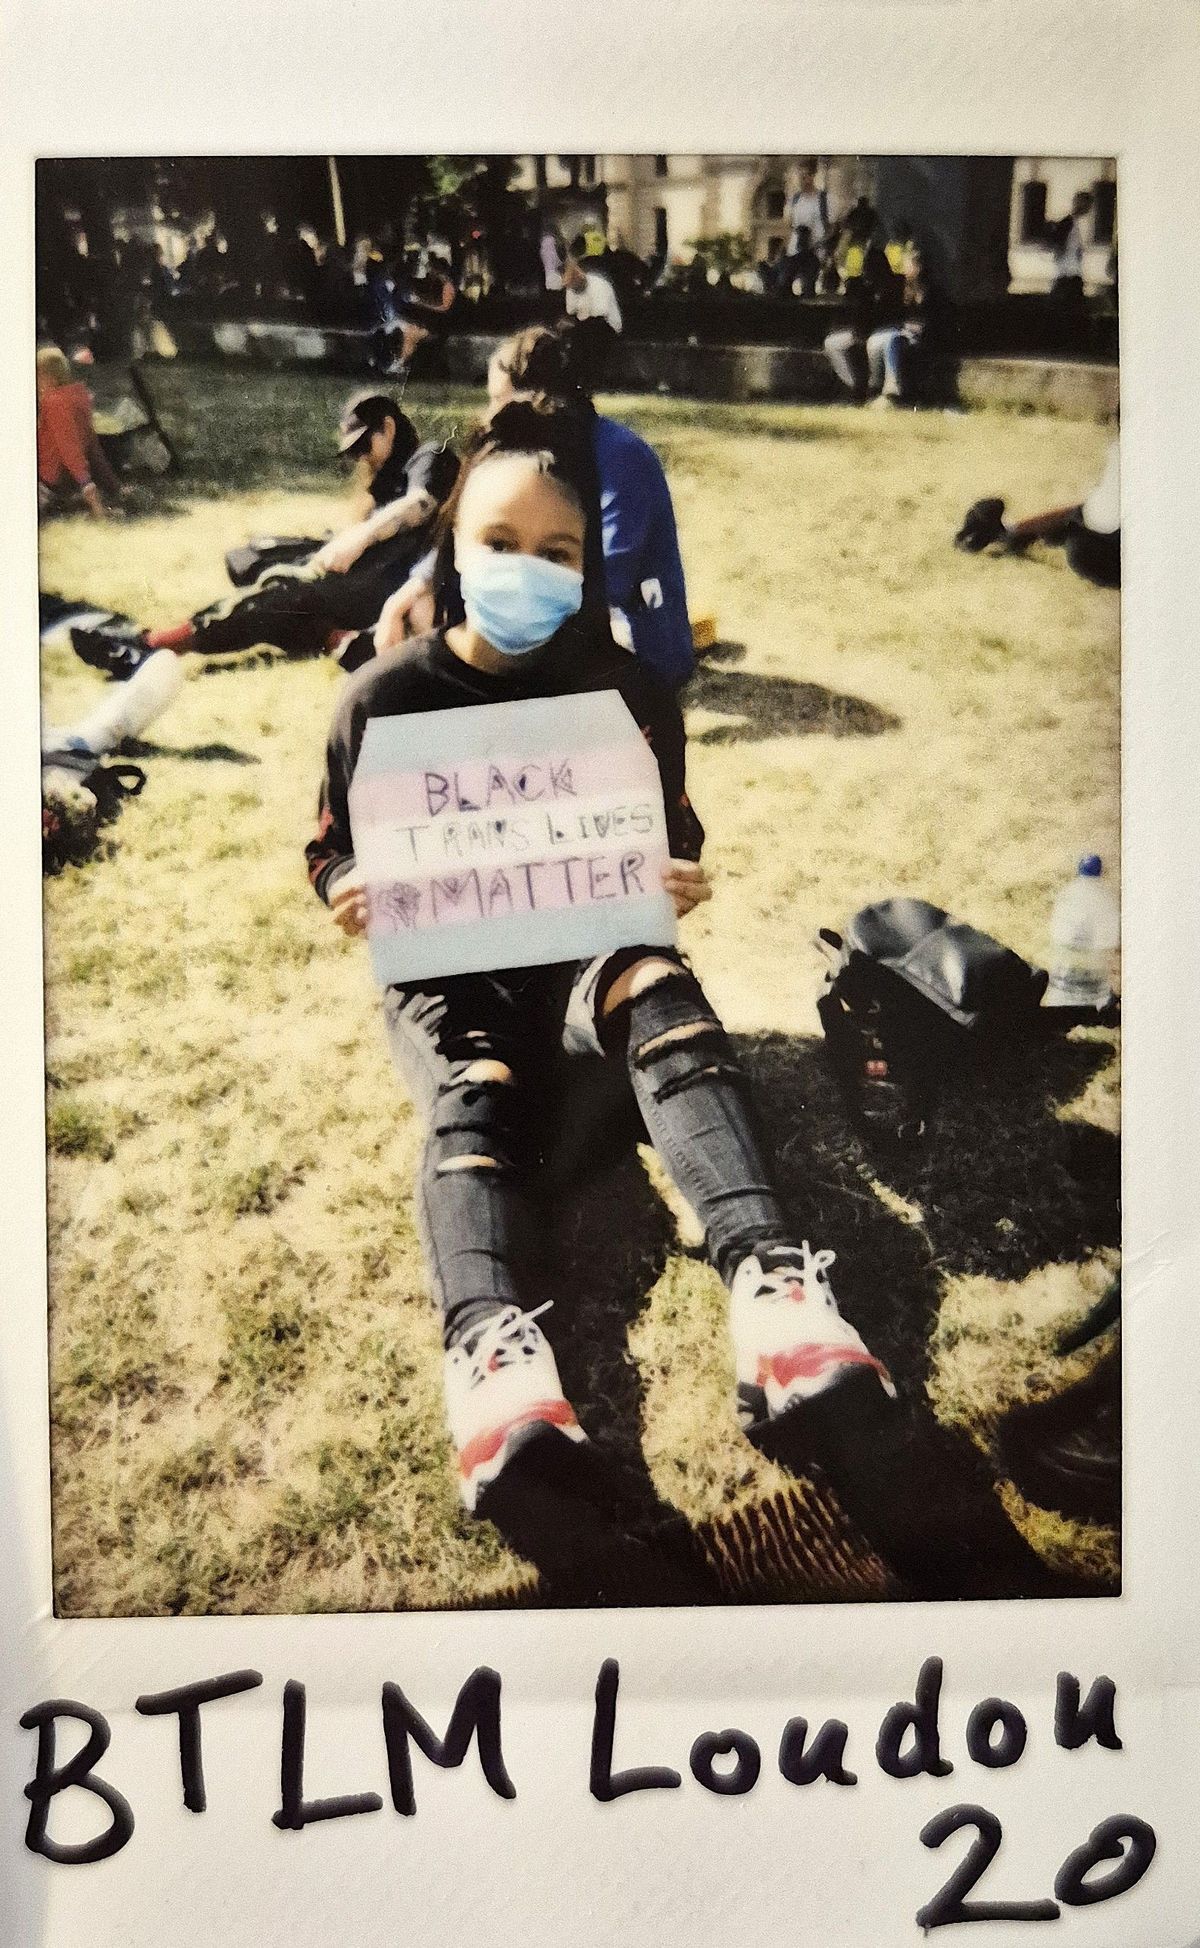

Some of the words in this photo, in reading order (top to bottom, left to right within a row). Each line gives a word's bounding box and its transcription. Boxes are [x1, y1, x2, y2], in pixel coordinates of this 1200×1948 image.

[424, 758, 577, 817] BLACK
[394, 819, 531, 862] TRANS
[546, 803, 654, 846] LIVES
[430, 850, 646, 919] MATTER
[20, 1666, 517, 1865] BTLM
[589, 1656, 1124, 1802] London
[915, 1803, 1157, 1937] 20
